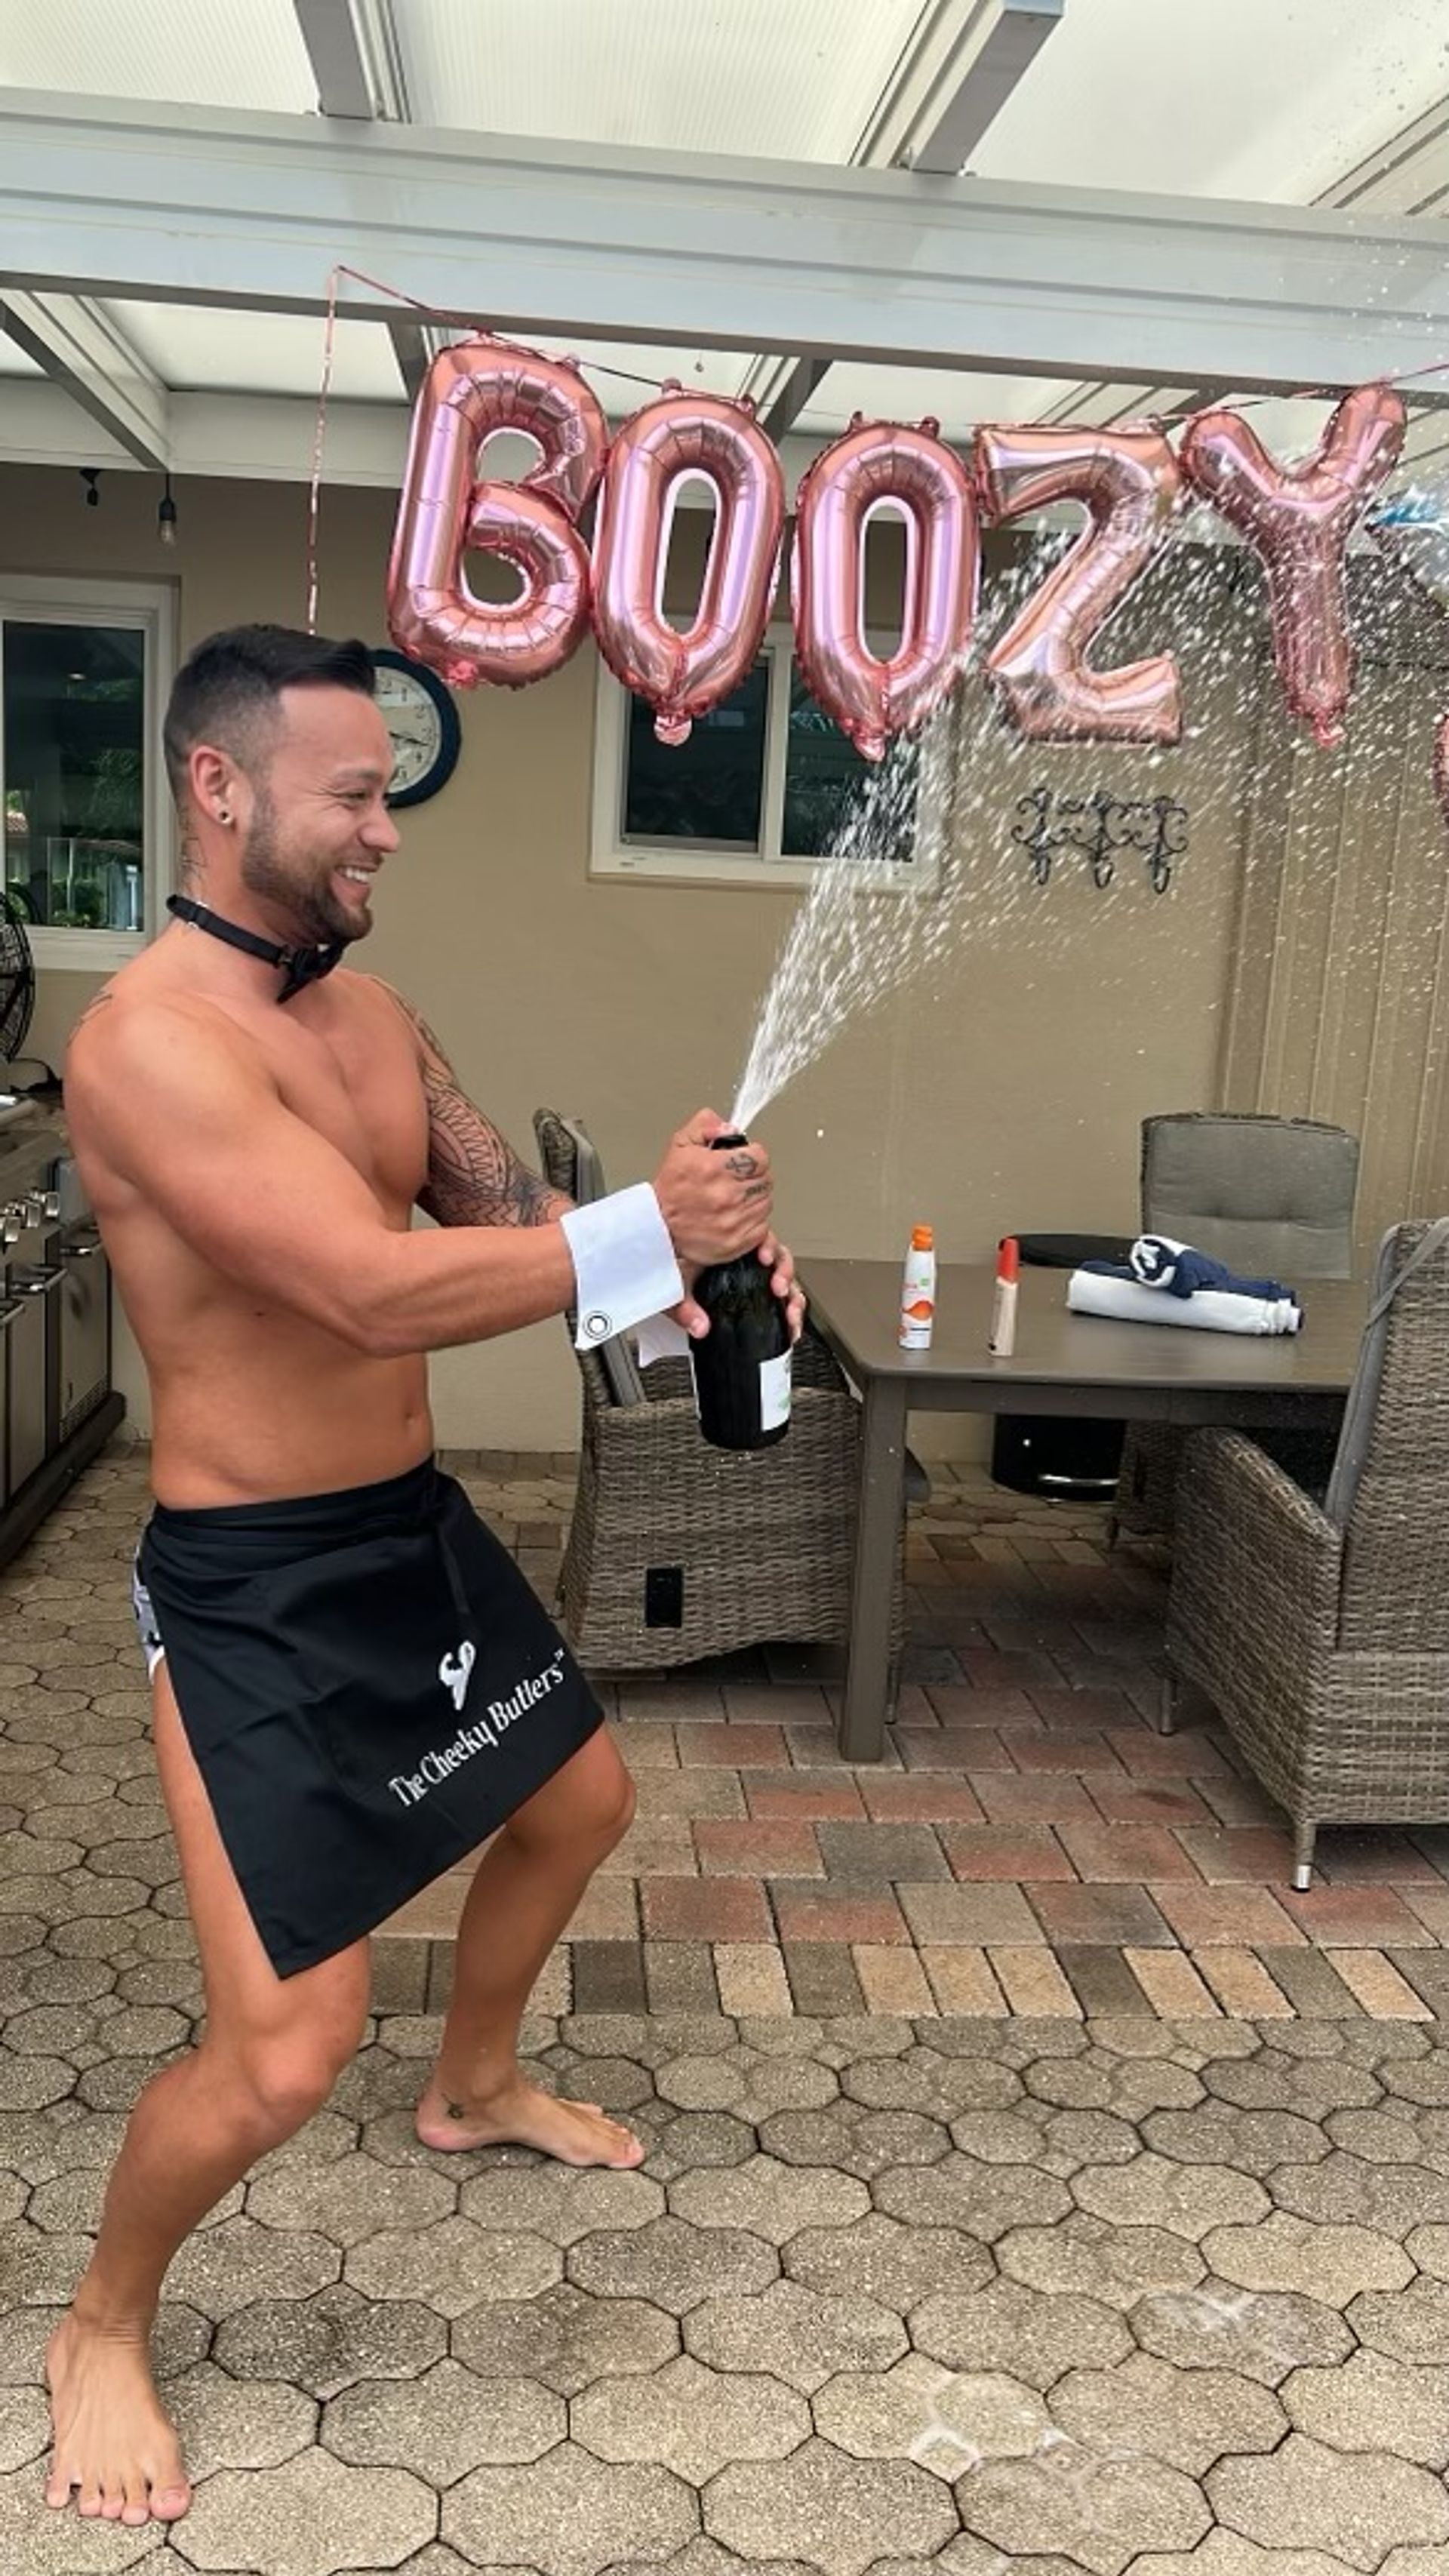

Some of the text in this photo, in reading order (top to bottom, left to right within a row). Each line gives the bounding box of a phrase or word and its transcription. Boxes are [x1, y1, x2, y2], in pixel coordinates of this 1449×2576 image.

[388, 337, 1407, 759] BOOZY
[388, 1663, 565, 1807] The Cheeky Butlers
